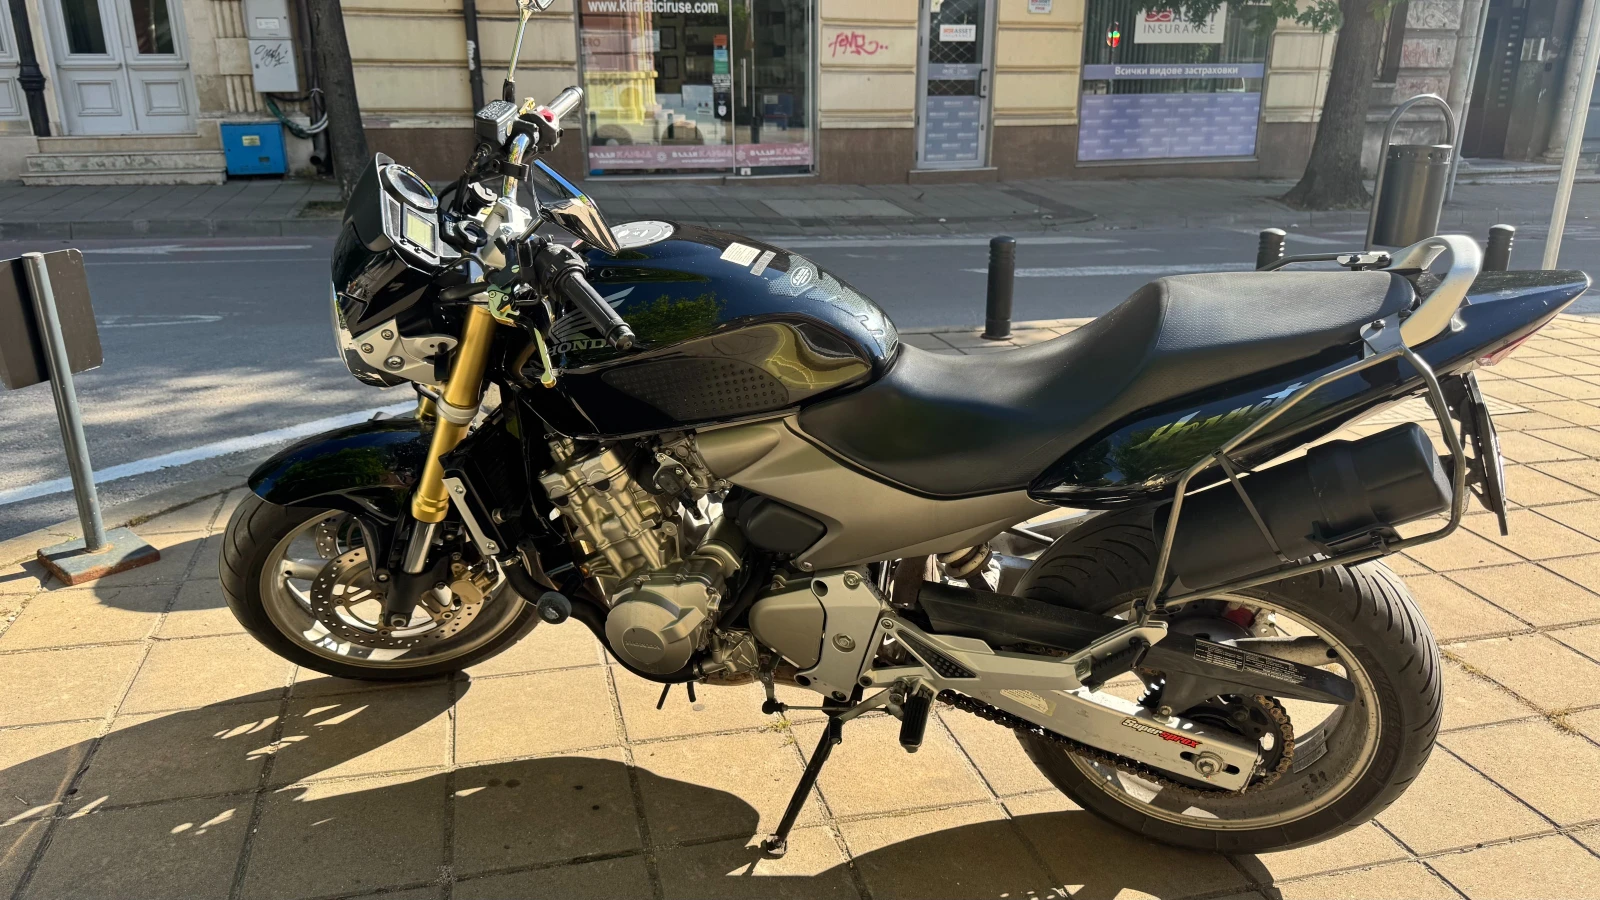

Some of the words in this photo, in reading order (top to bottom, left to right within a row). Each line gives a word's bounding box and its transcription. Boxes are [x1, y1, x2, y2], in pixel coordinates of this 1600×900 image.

[588, 0, 719, 14] www.klimaticiruse.com
[1143, 23, 1216, 35] INSURANCE
[1114, 66, 1148, 76] Всички
[1150, 67, 1183, 77] видове
[1184, 66, 1239, 76] застраховки
[547, 339, 612, 357] HOND
